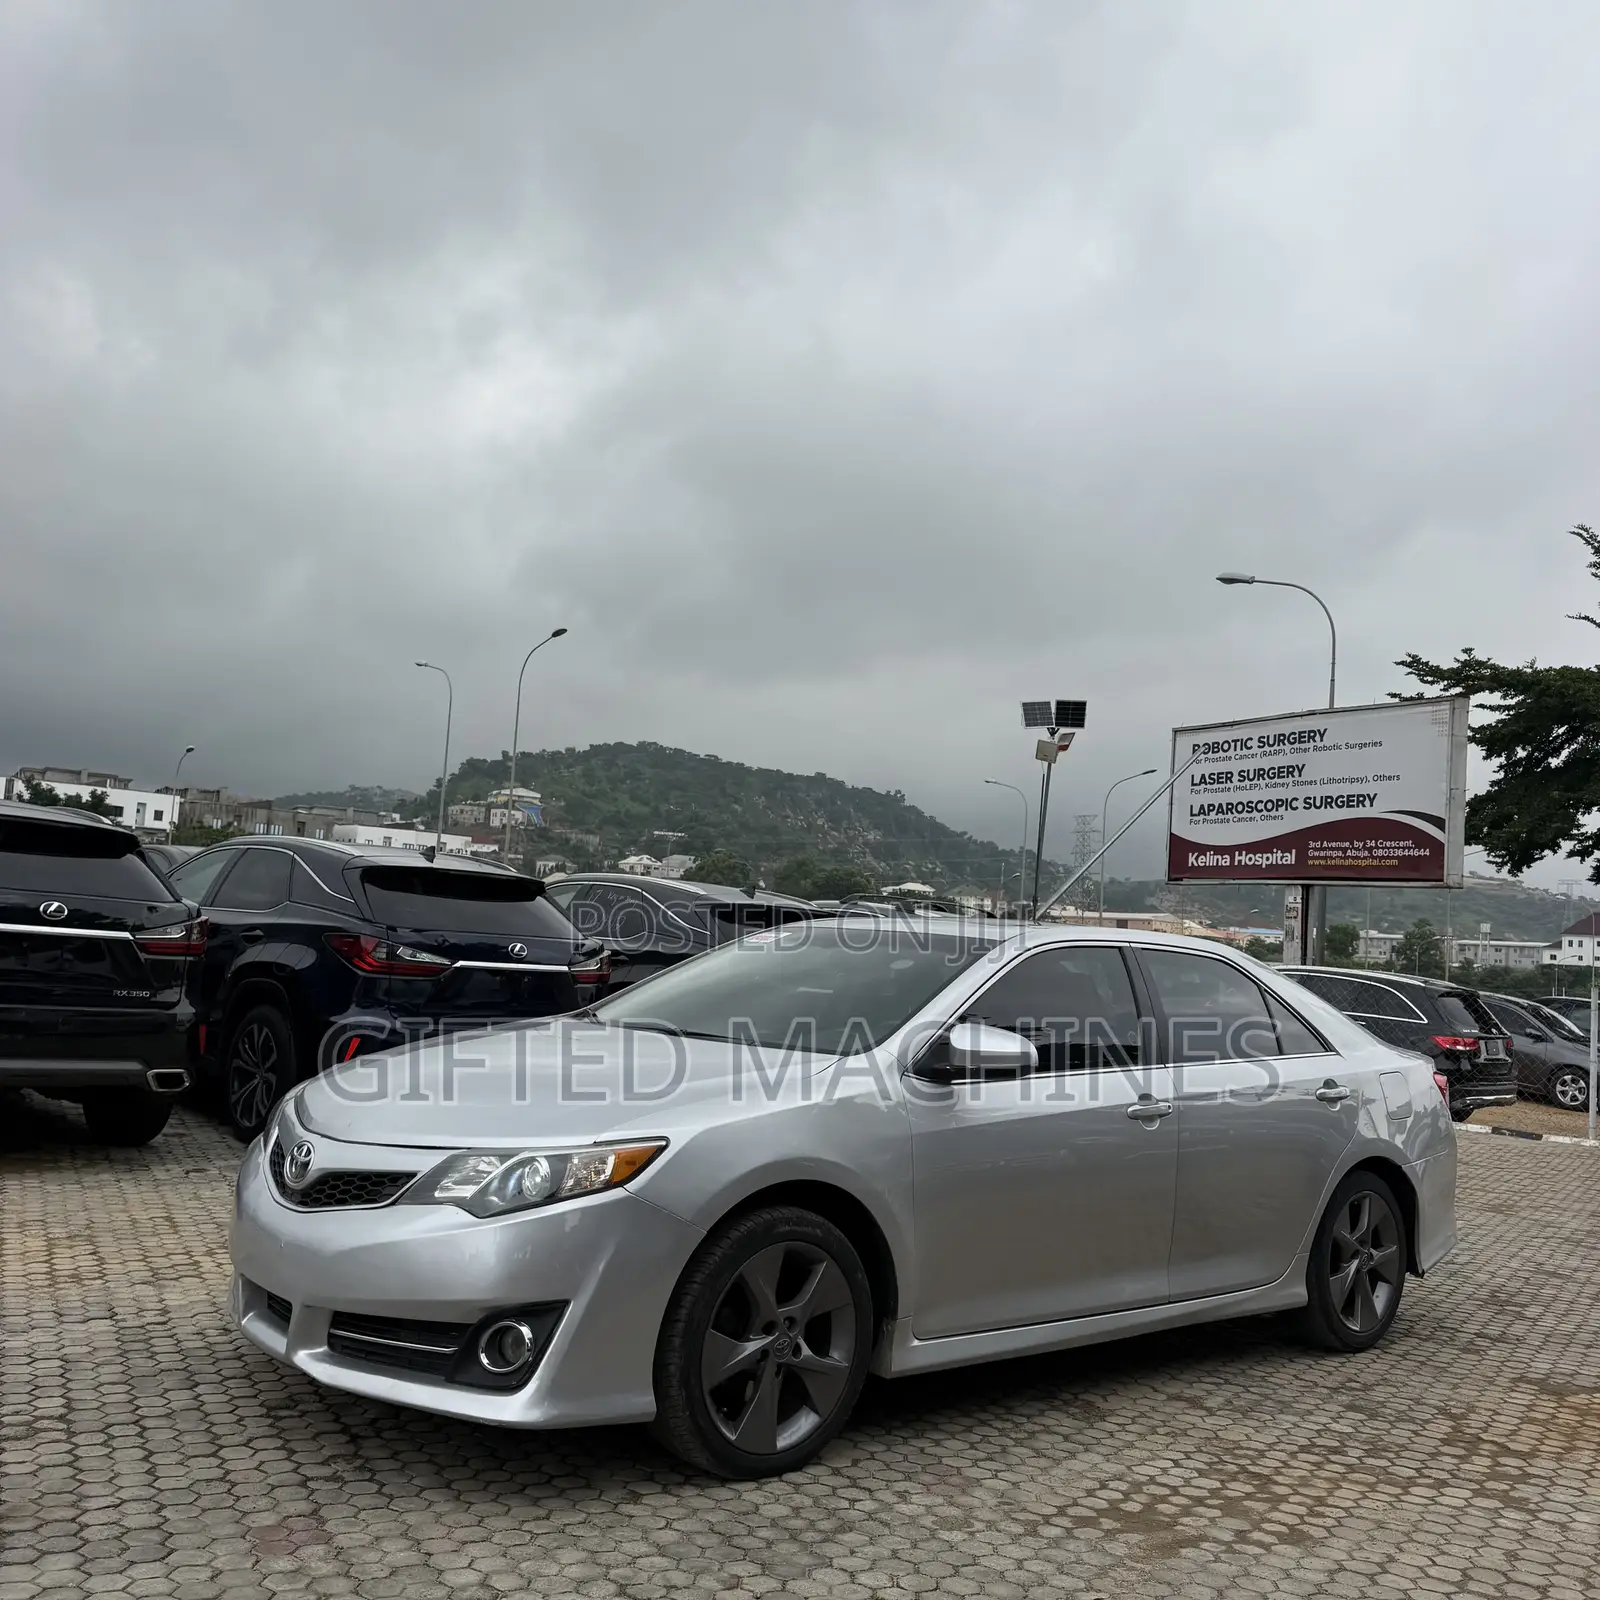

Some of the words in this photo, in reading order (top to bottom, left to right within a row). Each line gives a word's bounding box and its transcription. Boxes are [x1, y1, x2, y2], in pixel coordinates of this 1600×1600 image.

[1257, 728, 1328, 749] SURGERY
[1192, 757, 1203, 765] or
[1204, 755, 1233, 763] Prostate
[1234, 752, 1259, 761] Cancer
[1259, 748, 1288, 759] (RARP),
[1289, 746, 1311, 755] Other
[1312, 743, 1343, 752] Robotic
[1344, 740, 1383, 751] Surgeries
[1191, 771, 1234, 787] LASER
[1237, 764, 1306, 783] SURGERY
[1203, 786, 1232, 794] Prostate
[1233, 783, 1263, 793] (HoLEP),
[1264, 781, 1290, 789] Kidney
[1291, 779, 1318, 787] Stones
[1319, 776, 1370, 786] (Lithotripsy),
[1372, 774, 1401, 782] Others
[1190, 797, 1299, 817] LAPAROSCOPIC
[1303, 793, 1378, 810] SURGERY
[1202, 817, 1231, 825] Prostate
[1308, 840, 1321, 848] 3rd
[1322, 840, 1352, 849] Avenue,
[1354, 840, 1364, 849] by
[1377, 840, 1415, 848] Crescent,
[1308, 849, 1344, 858] Gwarinpa,
[1372, 848, 1430, 857] 08033644644
[1188, 850, 1230, 867] Kelina
[1234, 848, 1296, 868] Hospital
[1307, 858, 1398, 867] www.kelinahospital.com
